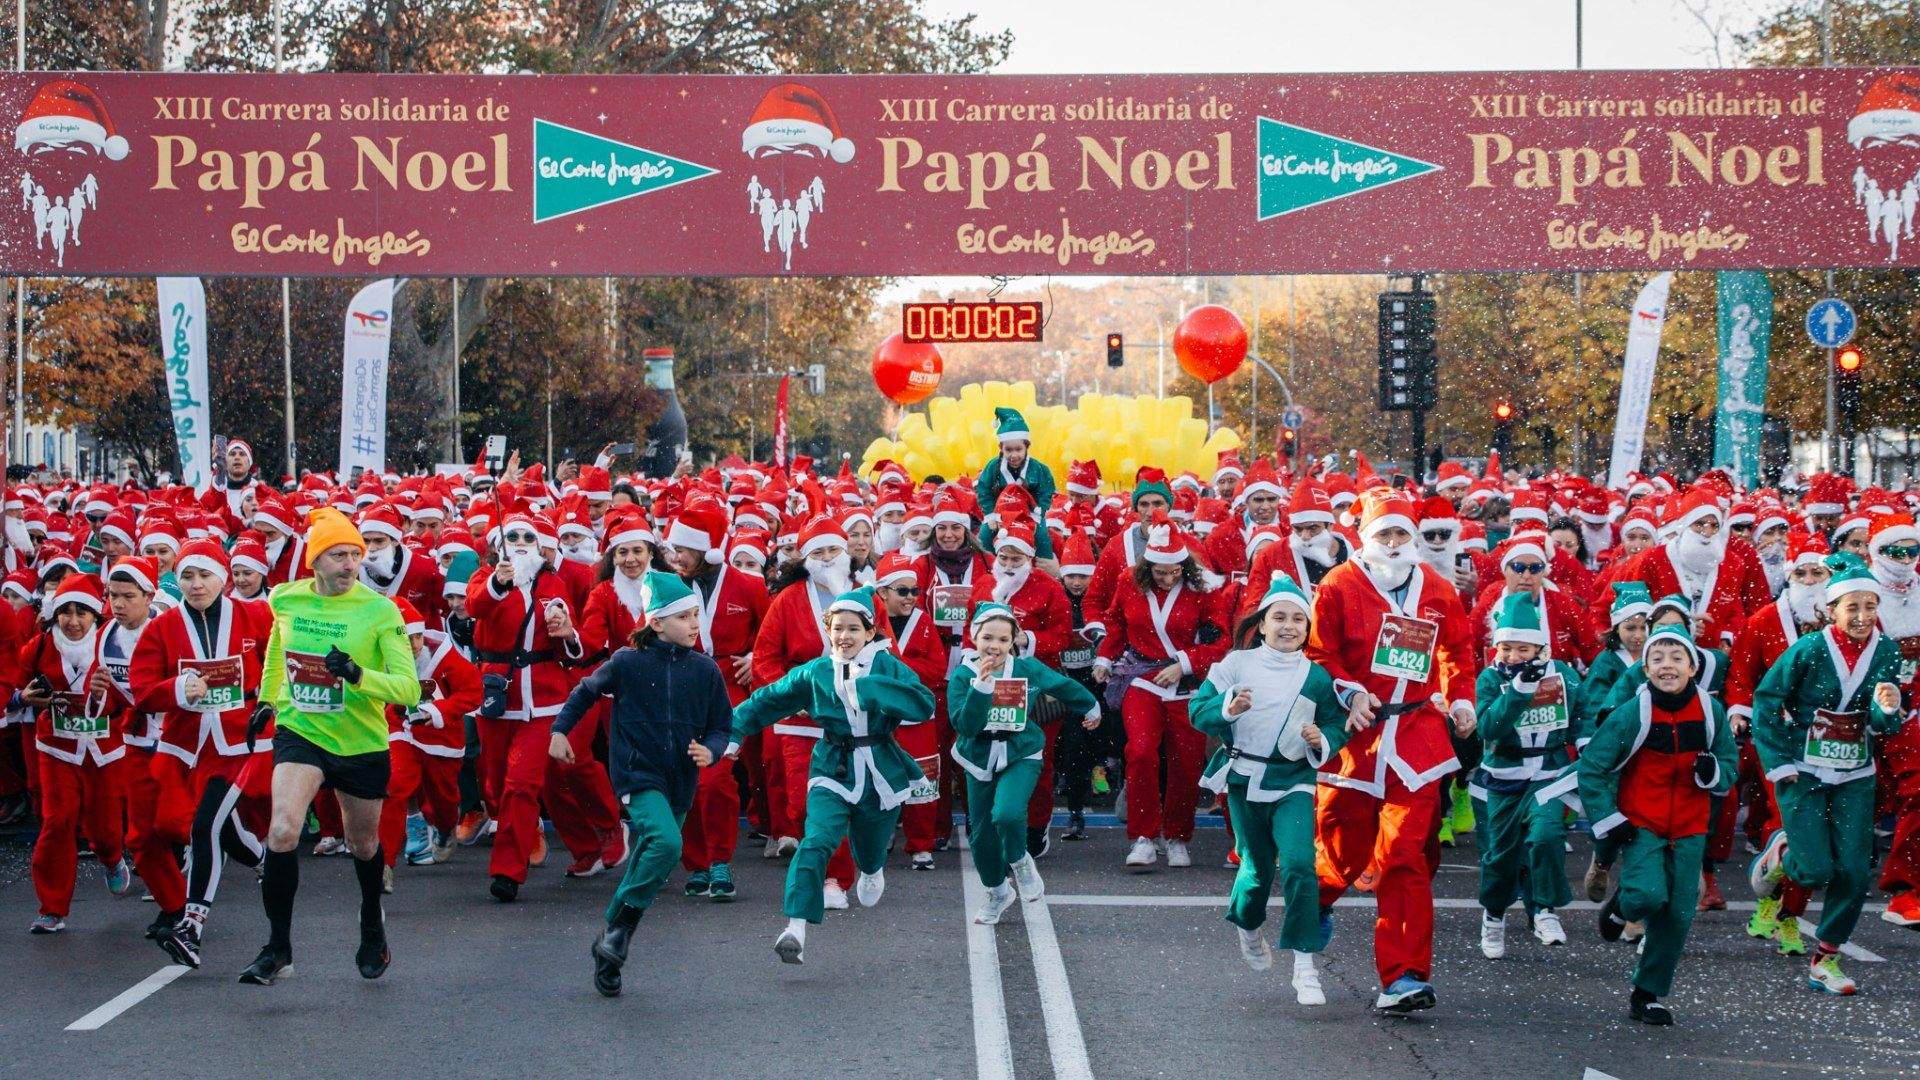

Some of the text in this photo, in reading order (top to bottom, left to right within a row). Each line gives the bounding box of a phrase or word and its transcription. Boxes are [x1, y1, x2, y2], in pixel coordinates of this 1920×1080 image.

[153, 97, 511, 122] XIII Carrera solidaria de
[879, 97, 1235, 121] XIII Carrera solidaria de
[1468, 91, 1825, 118] XIII Carrera solidaria de
[150, 132, 514, 209] Papá Noel
[539, 152, 675, 186] El Corte Inglés
[876, 131, 1238, 210] Papá Noel
[1262, 149, 1398, 183] El Corte Inglés
[1466, 126, 1829, 205] Papá Noel
[231, 218, 431, 265] El Corte Inglés
[957, 218, 1156, 266] El Corte Inglés
[1547, 213, 1750, 261] El Corte Inglés
[906, 305, 1037, 339] 00:00:02
[1389, 648, 1425, 672] 6424
[293, 684, 331, 703] 8444
[1520, 706, 1556, 726] 2888
[1820, 740, 1859, 759] 5303
